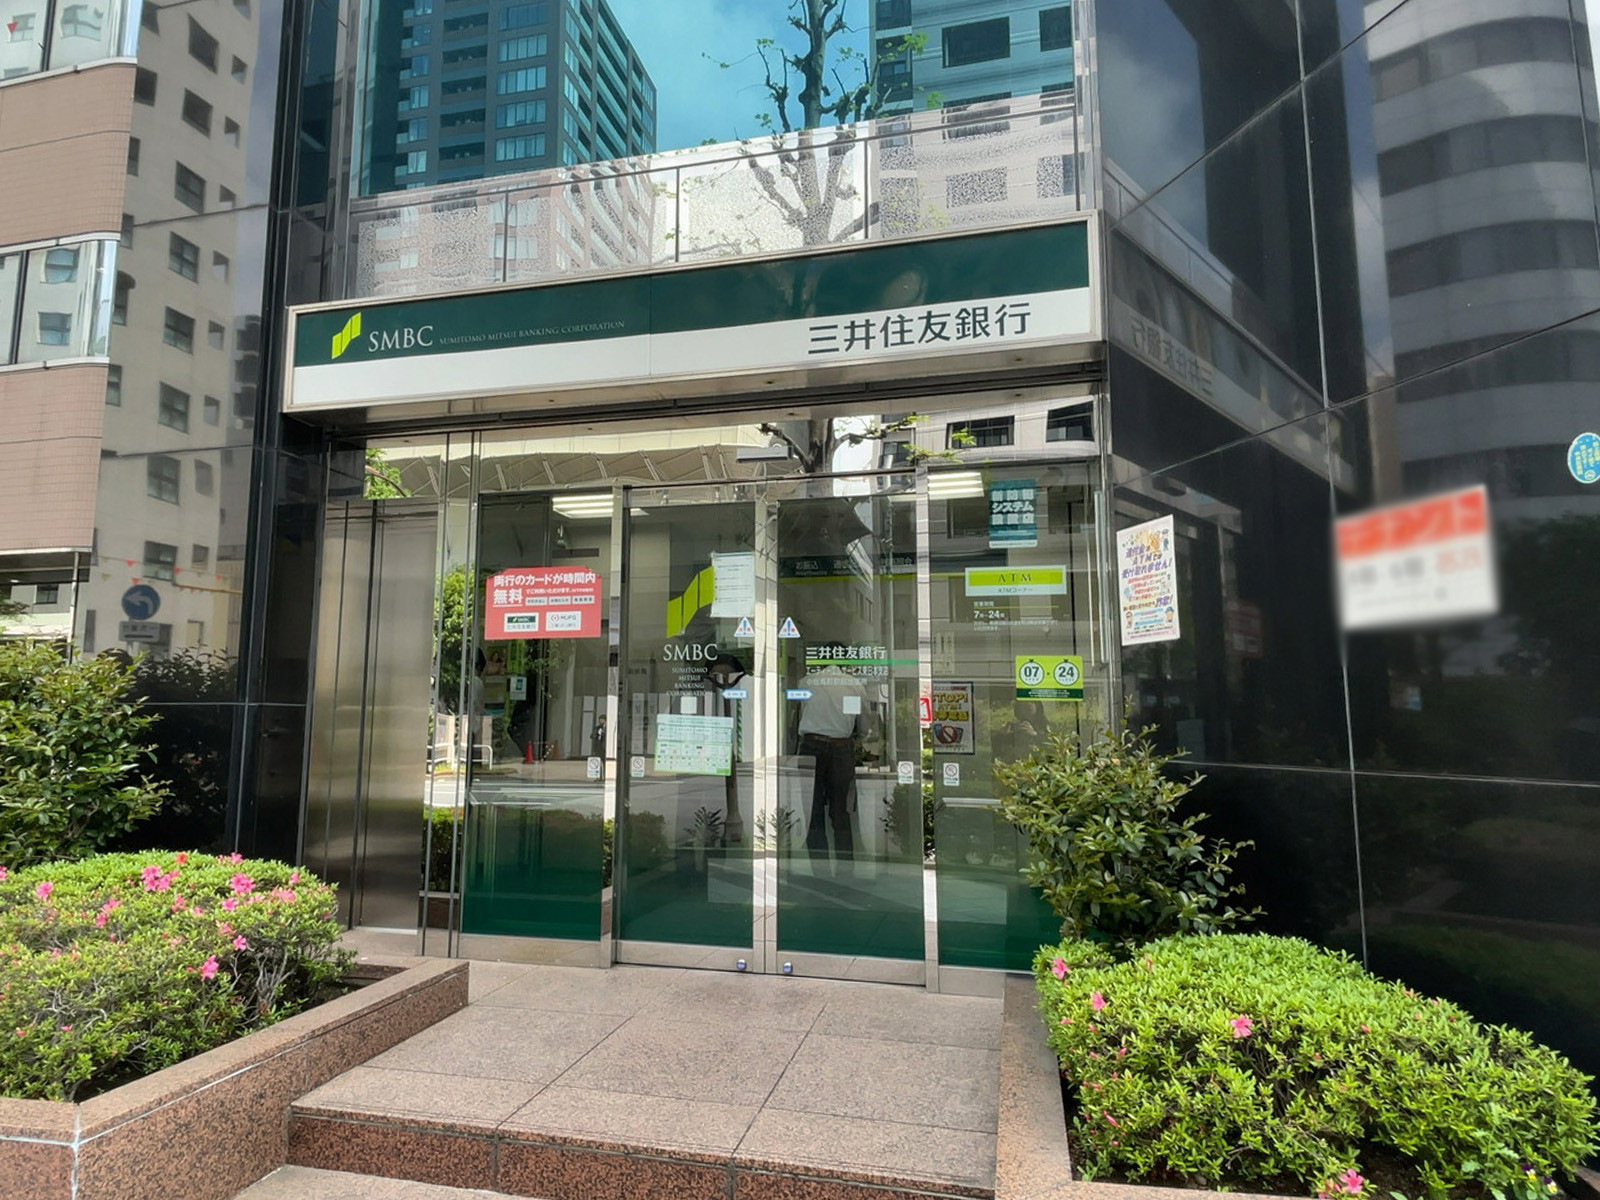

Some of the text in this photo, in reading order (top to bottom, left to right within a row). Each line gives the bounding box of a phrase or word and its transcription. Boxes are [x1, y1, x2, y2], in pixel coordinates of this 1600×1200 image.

[808, 302, 1031, 354] 三井住友銀行
[369, 320, 626, 353] SMBC SUMITOMO MITSUI BANKING CORPORATION
[494, 572, 596, 588] 両行のカードが時間内
[998, 573, 1032, 582] ATM
[493, 588, 522, 604] 無料
[663, 643, 718, 661] SMBC
[806, 646, 886, 659] 三井住友銀行
[672, 666, 708, 674] SUMITOMO
[1024, 666, 1039, 678] 07
[1058, 666, 1075, 678] 24
